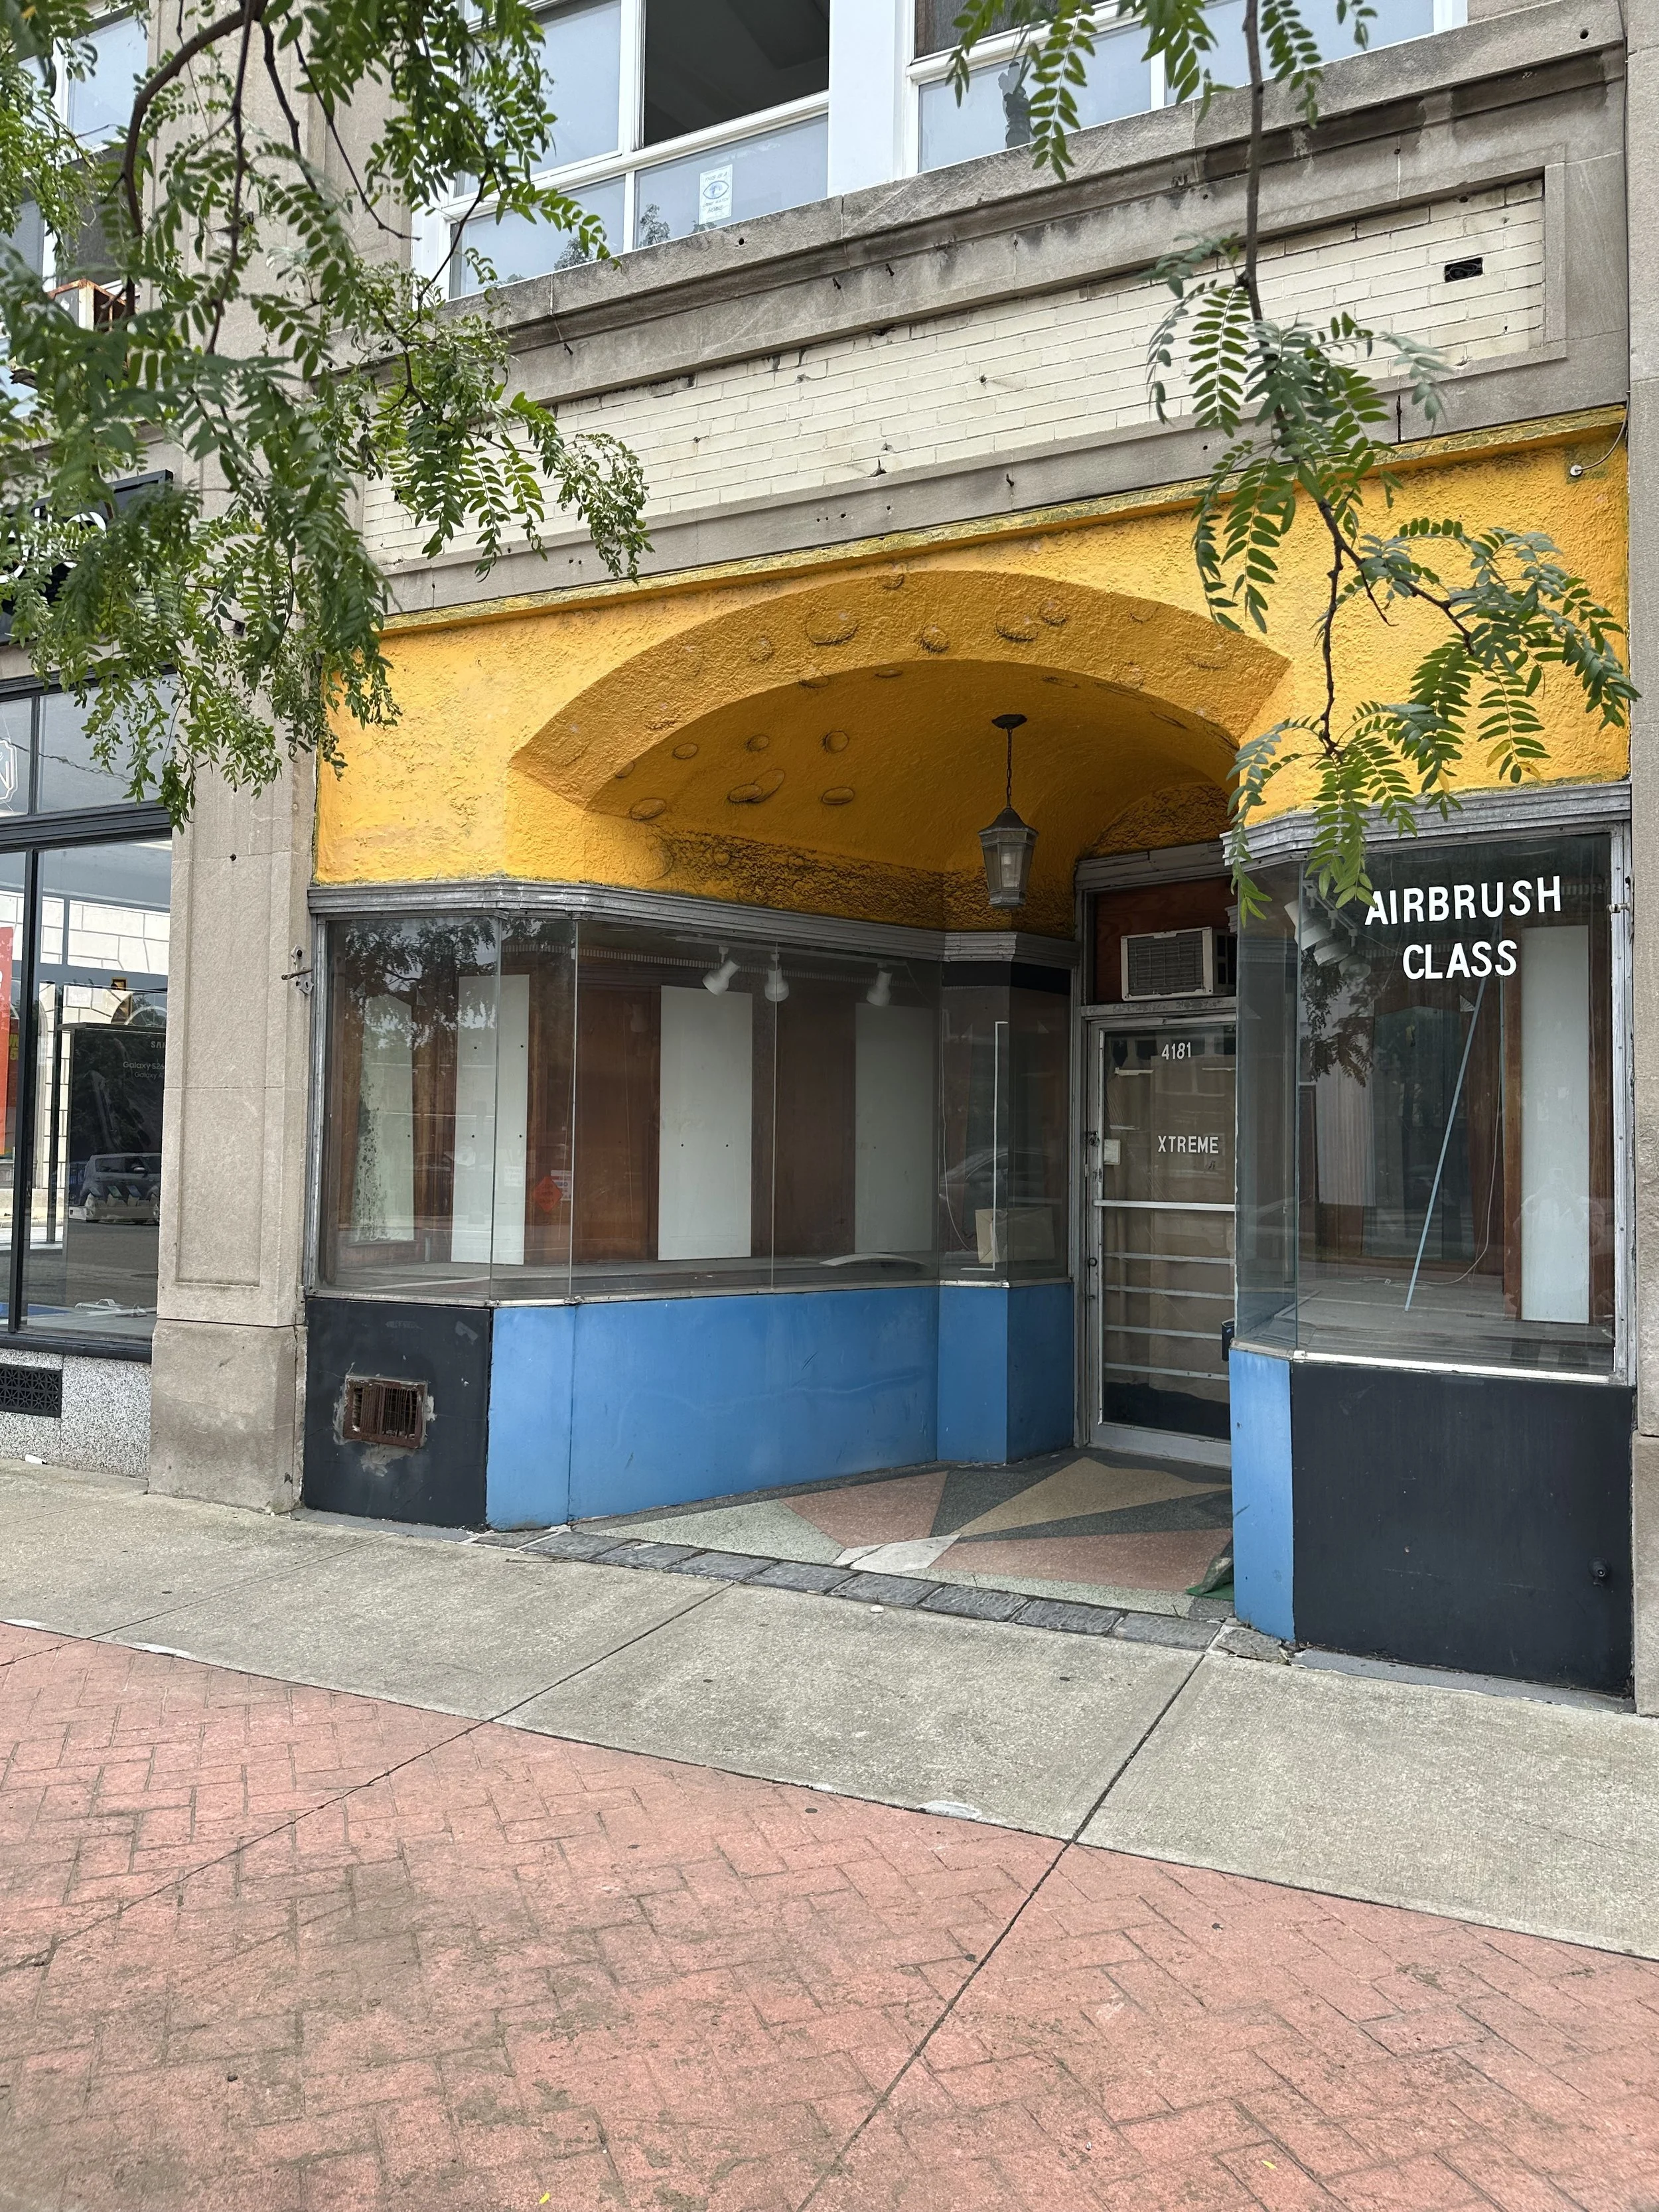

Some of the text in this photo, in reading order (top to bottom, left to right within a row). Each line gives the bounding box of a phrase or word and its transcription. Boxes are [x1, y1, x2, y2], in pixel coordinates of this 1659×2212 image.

[1364, 875, 1561, 926] AIRBRUSH
[1402, 940, 1518, 980] CLASS
[1161, 1042, 1191, 1060] 4181
[123, 1061, 151, 1070] Galaxy
[1158, 1136, 1219, 1154] XTREME
